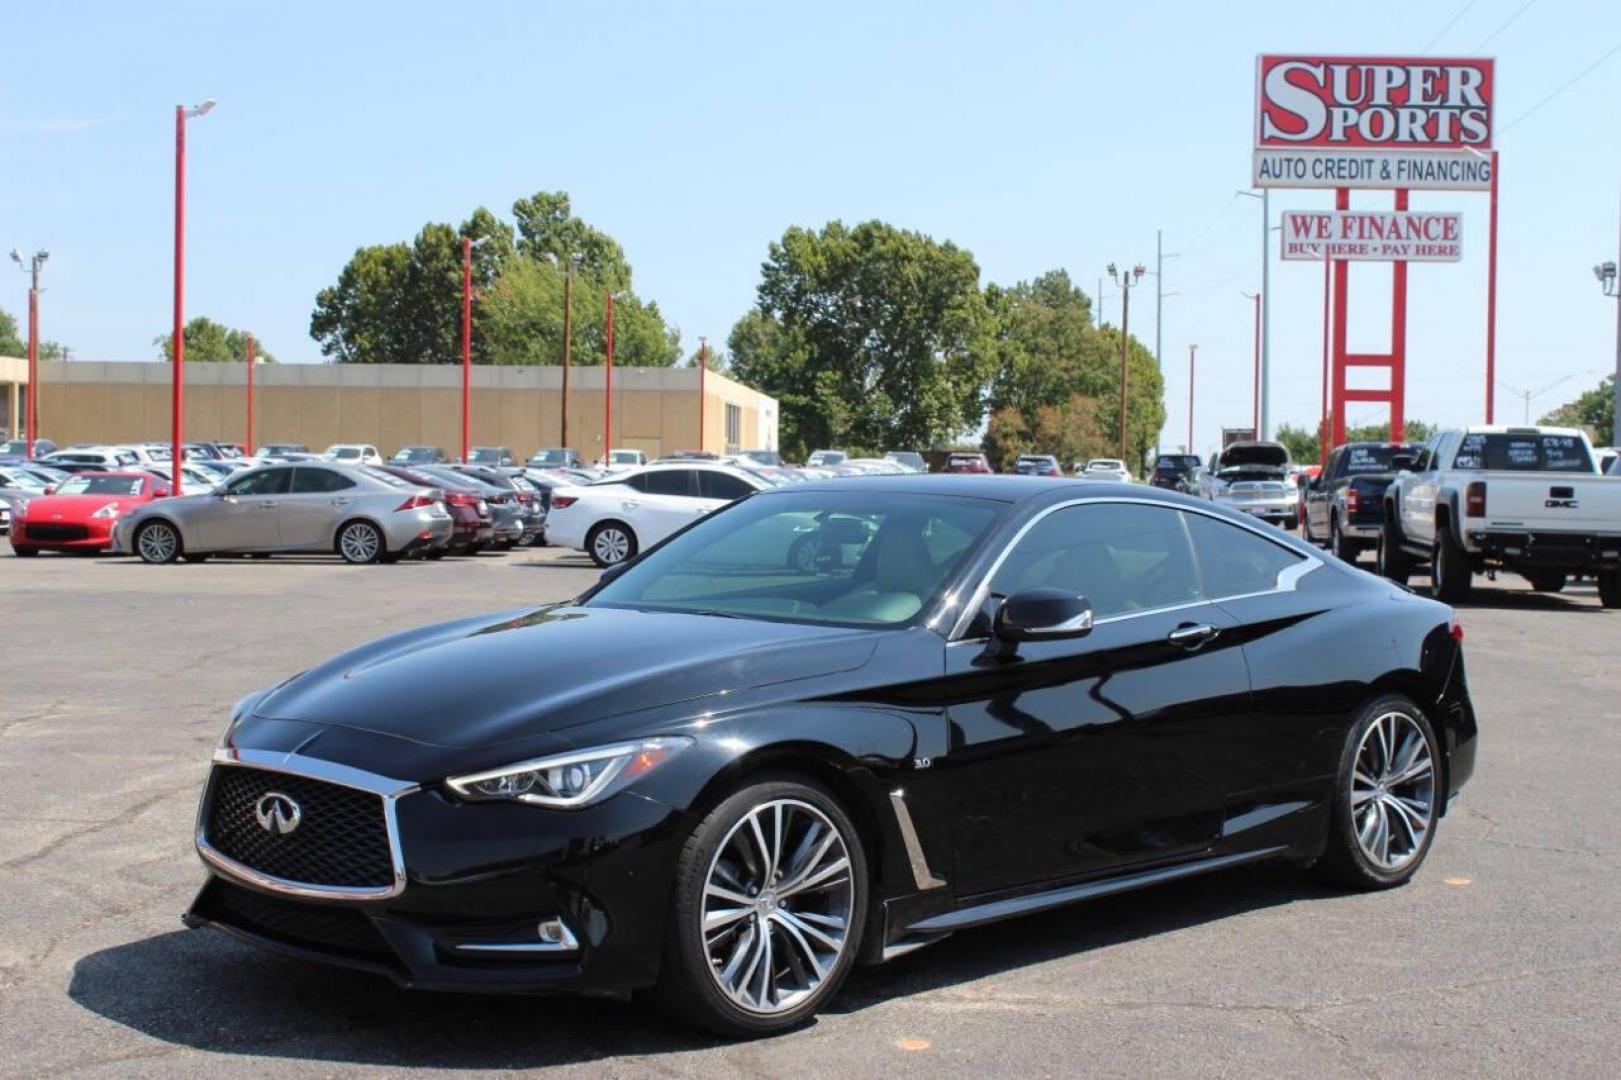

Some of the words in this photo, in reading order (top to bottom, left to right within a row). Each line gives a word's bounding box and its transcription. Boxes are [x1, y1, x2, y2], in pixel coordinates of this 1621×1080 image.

[1264, 61, 1487, 141] SUPER
[1259, 158, 1307, 180] AUTO
[1312, 159, 1375, 180] CREDIT
[1380, 160, 1392, 180] &
[1397, 160, 1491, 182] FINANCING
[1290, 214, 1333, 239] WE
[1341, 215, 1459, 241] FINANCE
[1288, 242, 1321, 254] BUY
[1325, 243, 1369, 256] HERE
[1382, 244, 1409, 256] PAY
[1416, 245, 1460, 258] HERE
